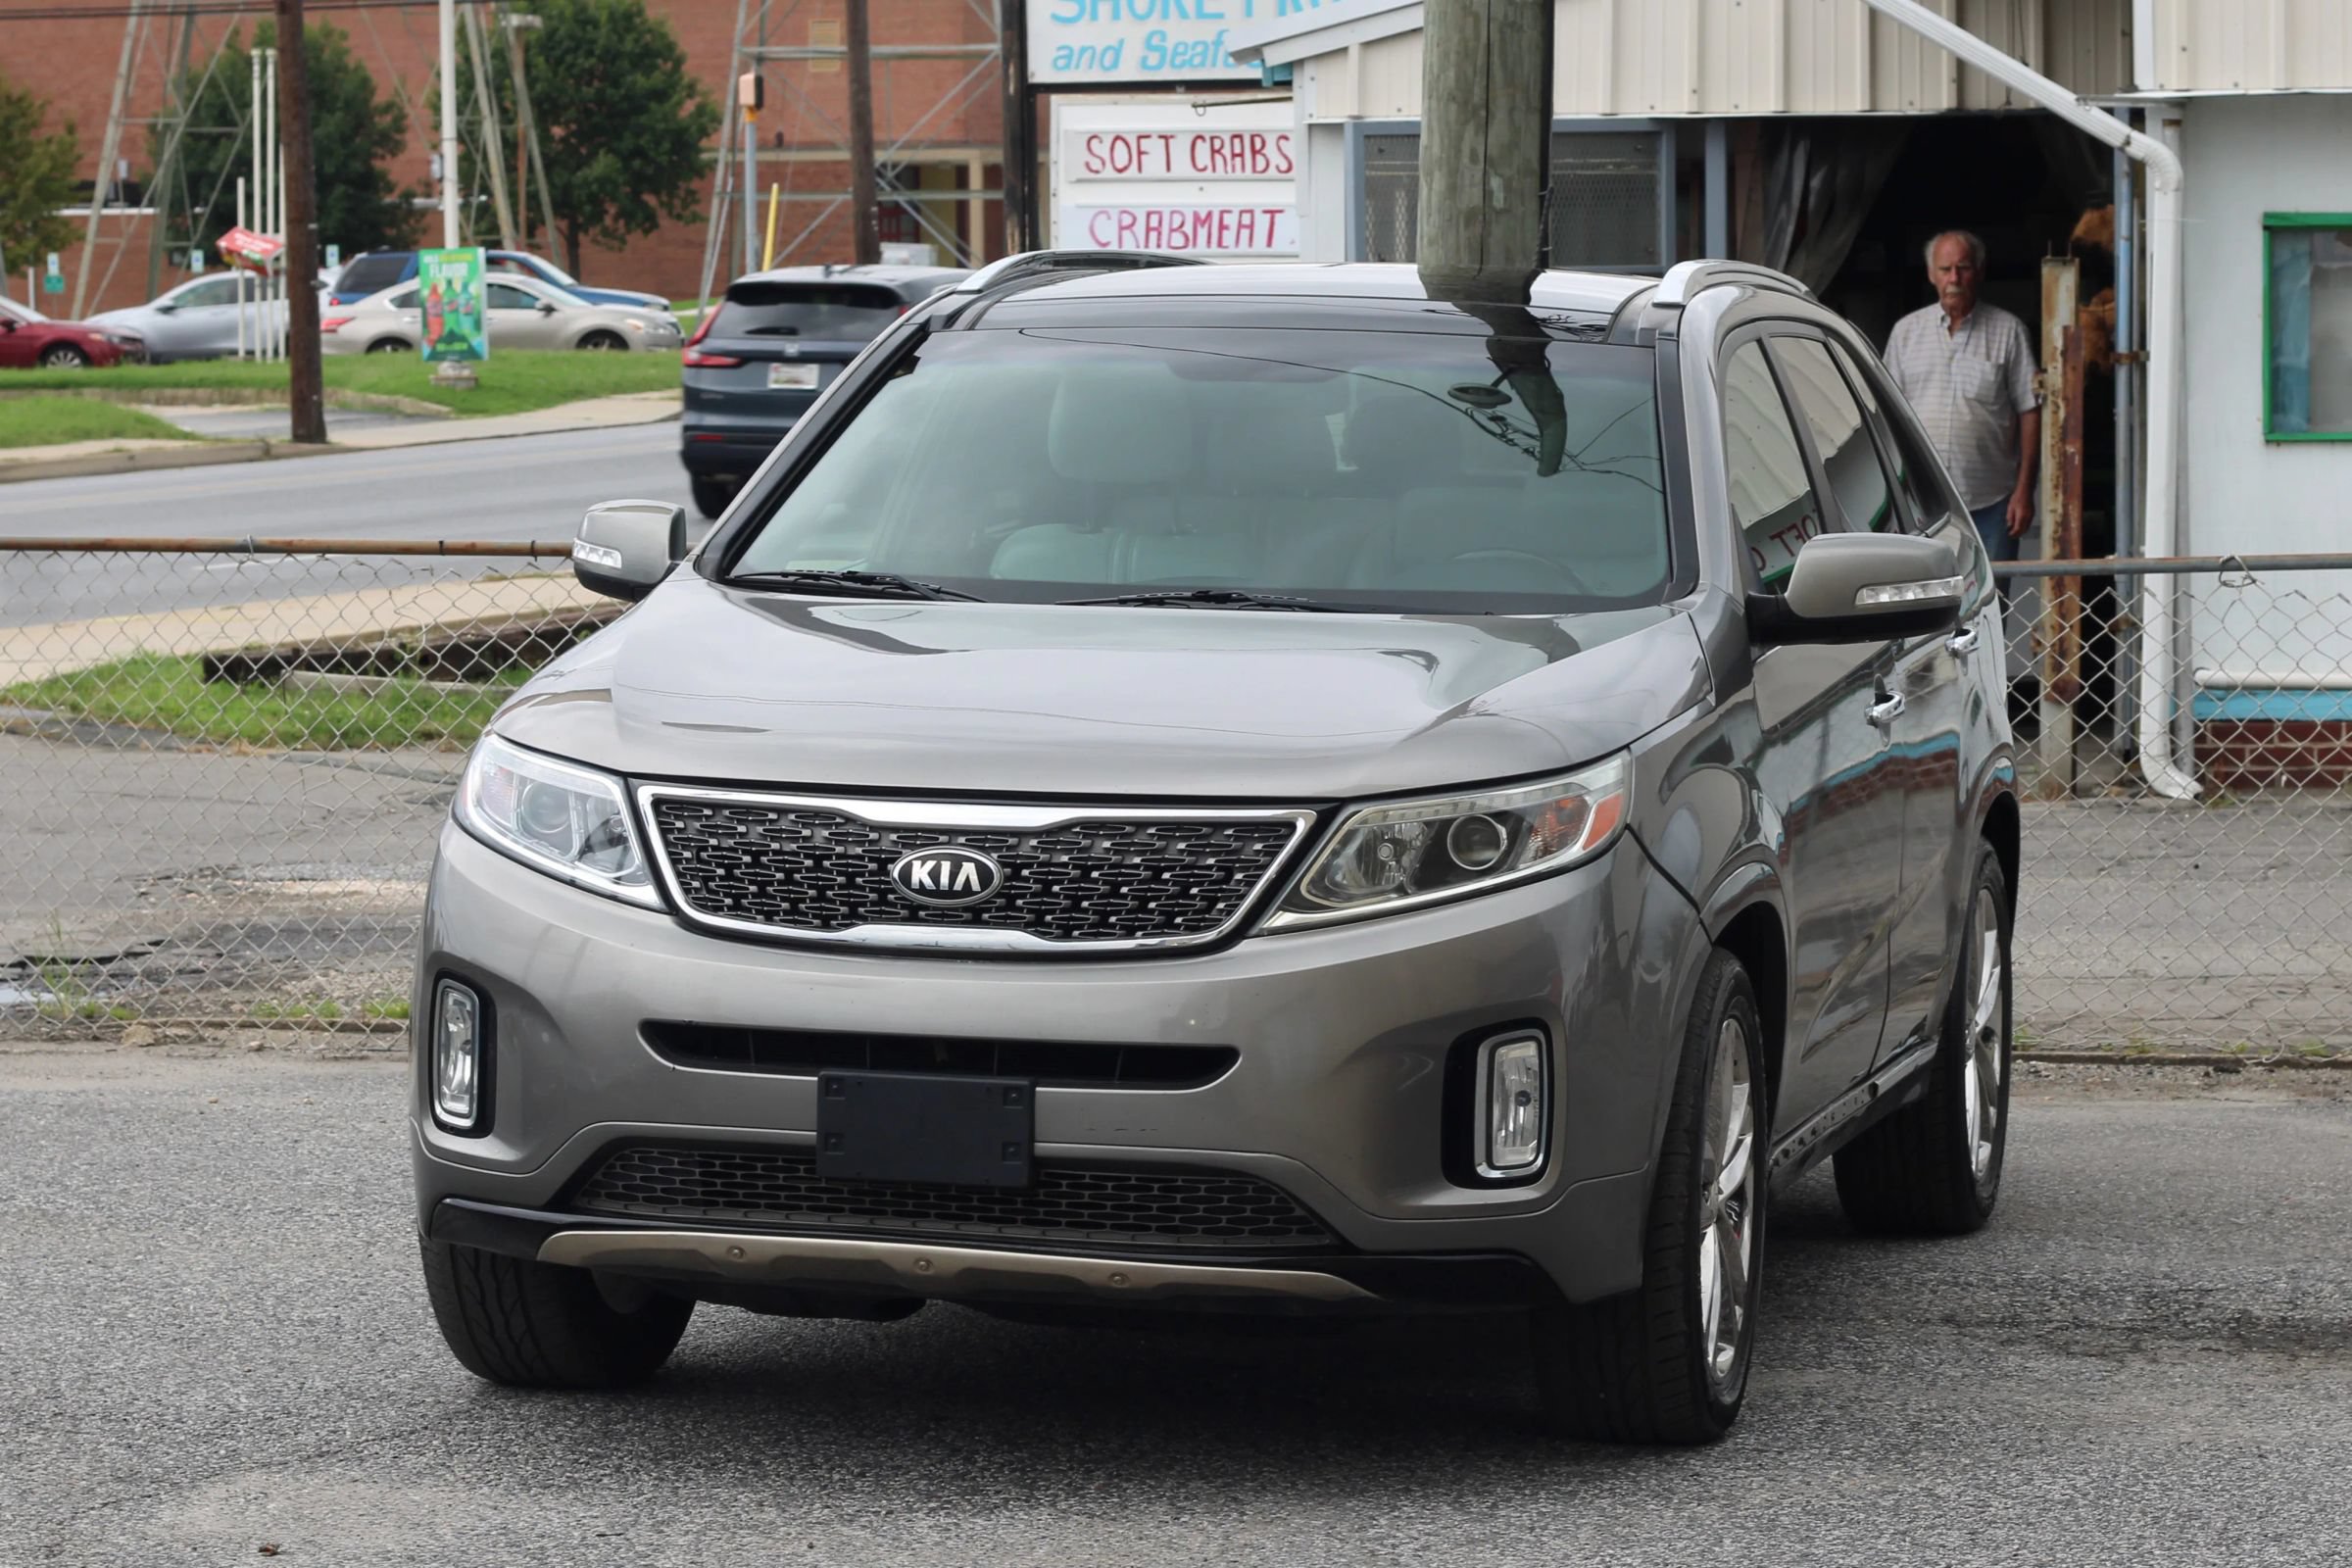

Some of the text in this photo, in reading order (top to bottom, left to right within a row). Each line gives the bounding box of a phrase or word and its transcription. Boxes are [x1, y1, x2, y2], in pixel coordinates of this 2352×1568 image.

[1052, 38, 1124, 72] and
[1085, 133, 1294, 173] SOFT CRABS
[1089, 209, 1285, 250] CRABMEAT
[910, 859, 982, 892] KIA
